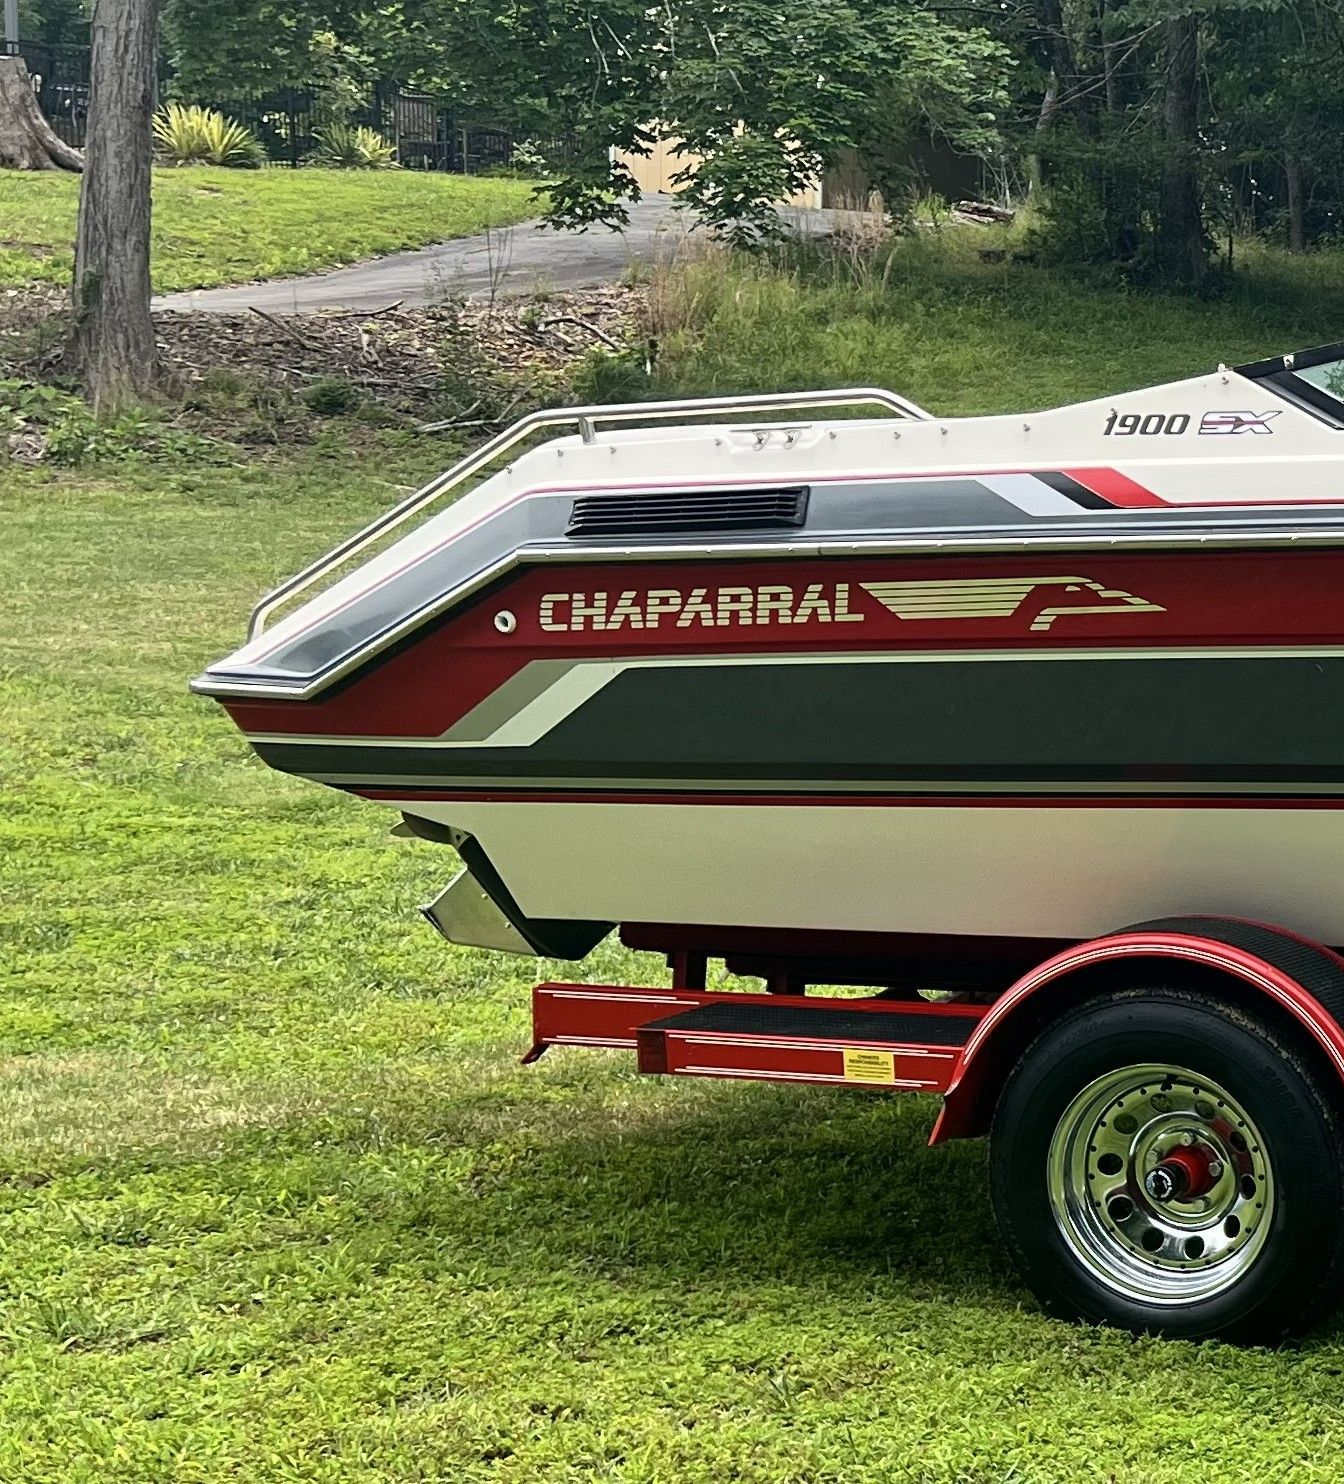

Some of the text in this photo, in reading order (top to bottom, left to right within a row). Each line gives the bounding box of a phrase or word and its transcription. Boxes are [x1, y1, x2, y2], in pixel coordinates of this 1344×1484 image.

[1103, 410, 1283, 435] 1900 SX
[539, 583, 865, 632] CHAPARRAL
